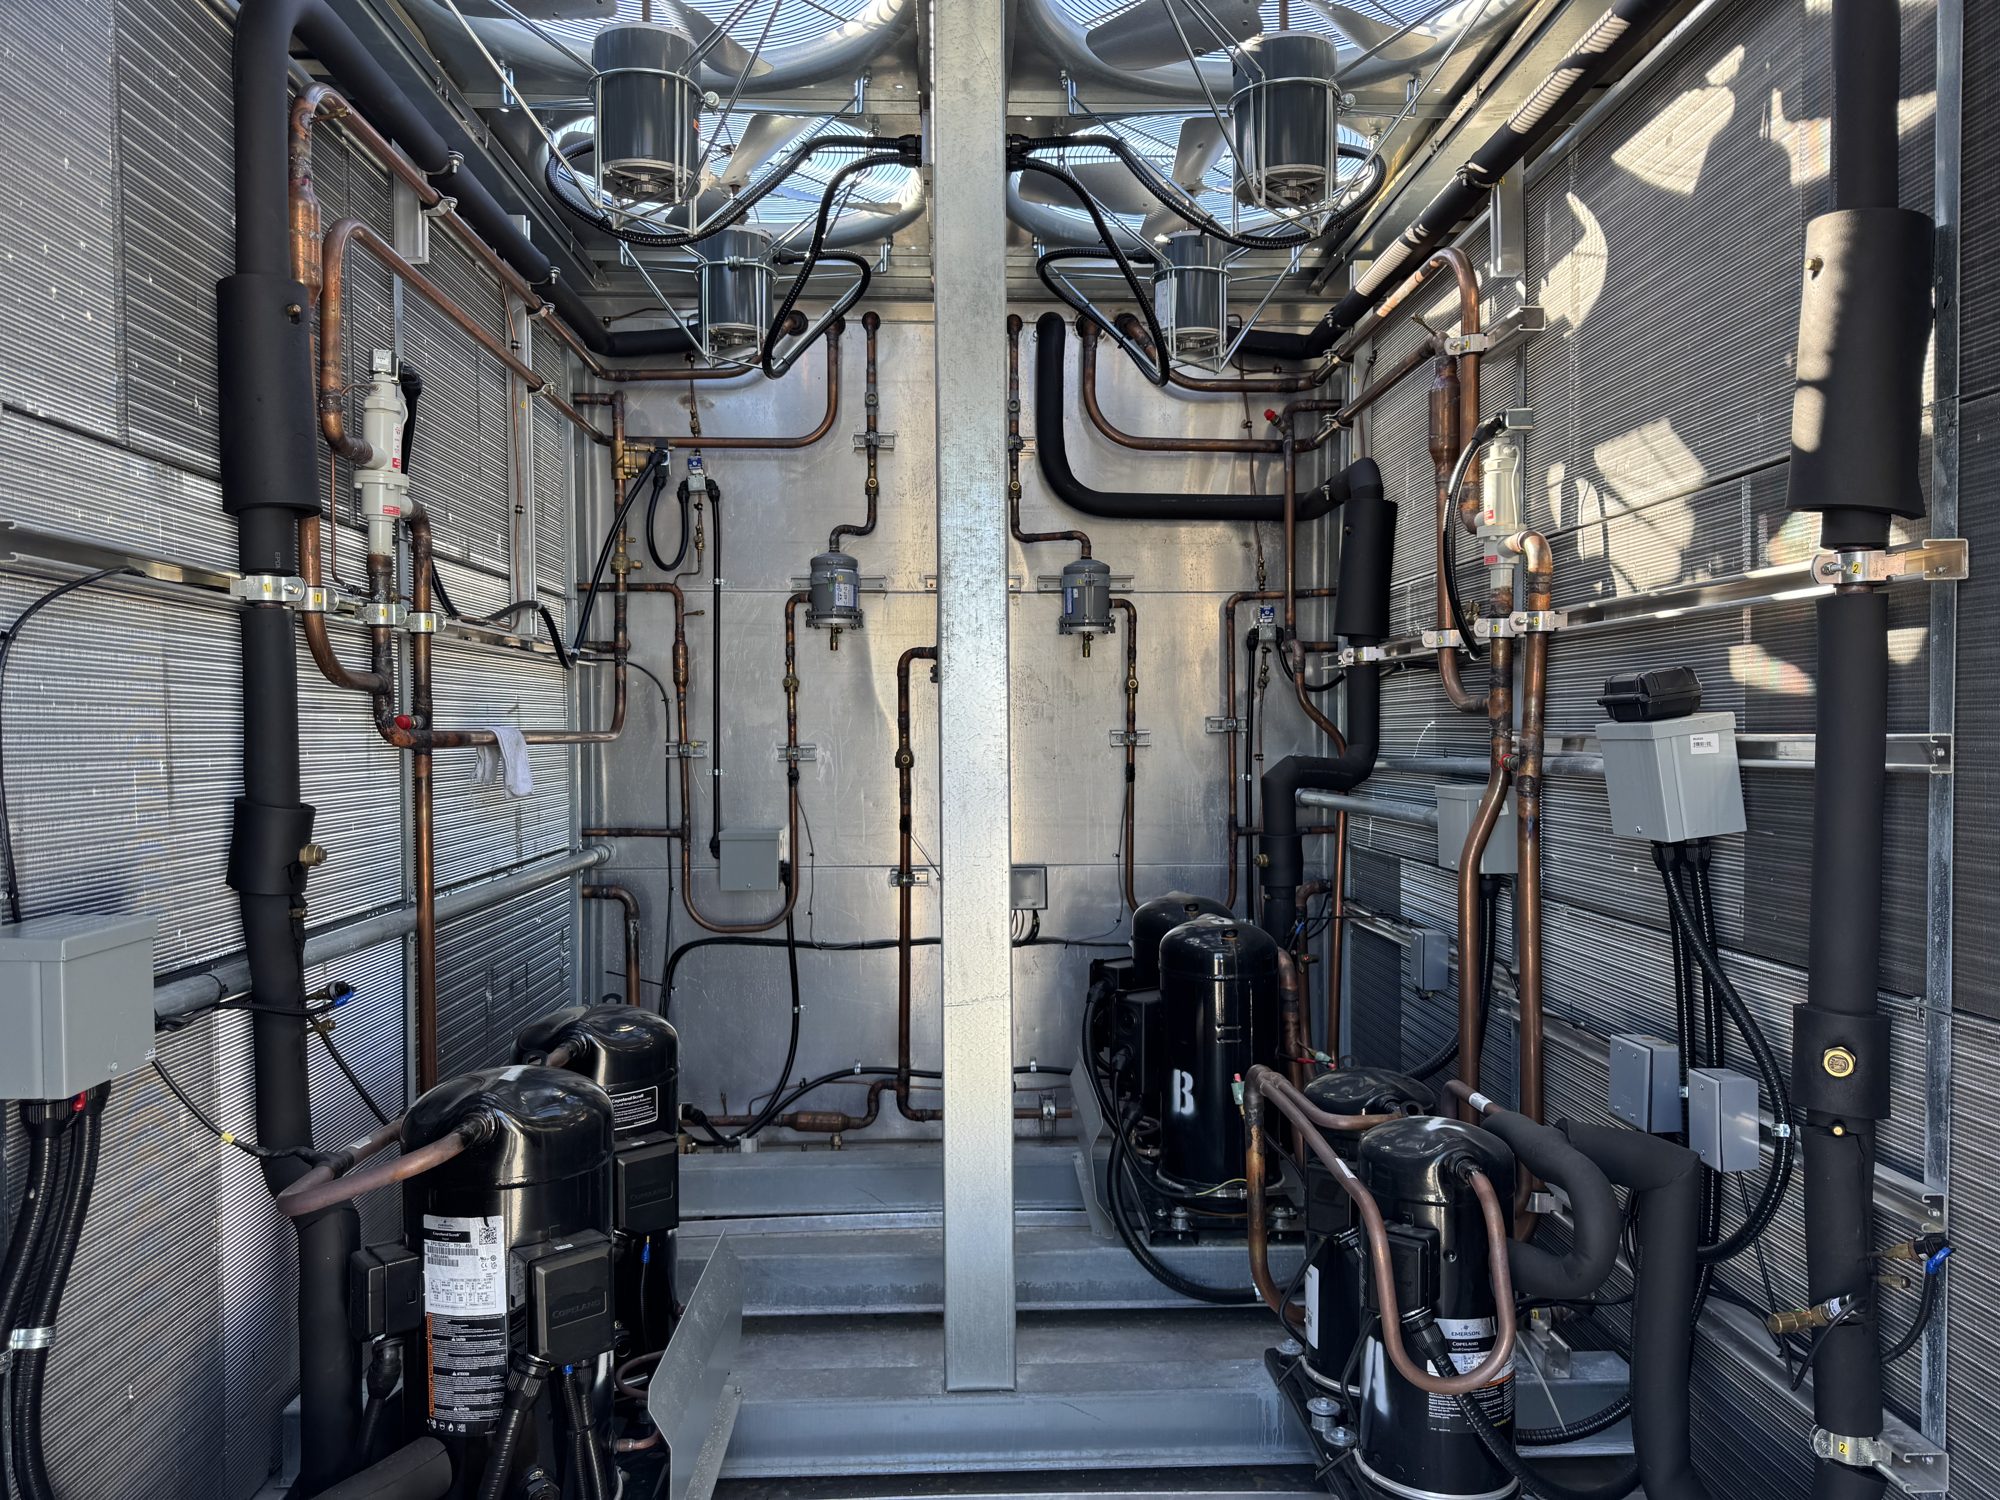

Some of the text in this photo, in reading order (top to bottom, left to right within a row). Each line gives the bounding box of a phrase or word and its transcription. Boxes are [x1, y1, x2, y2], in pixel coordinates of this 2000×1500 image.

[1852, 563, 1859, 574] 2
[1173, 1069, 1194, 1116] B
[1840, 1443, 1846, 1453] 2
